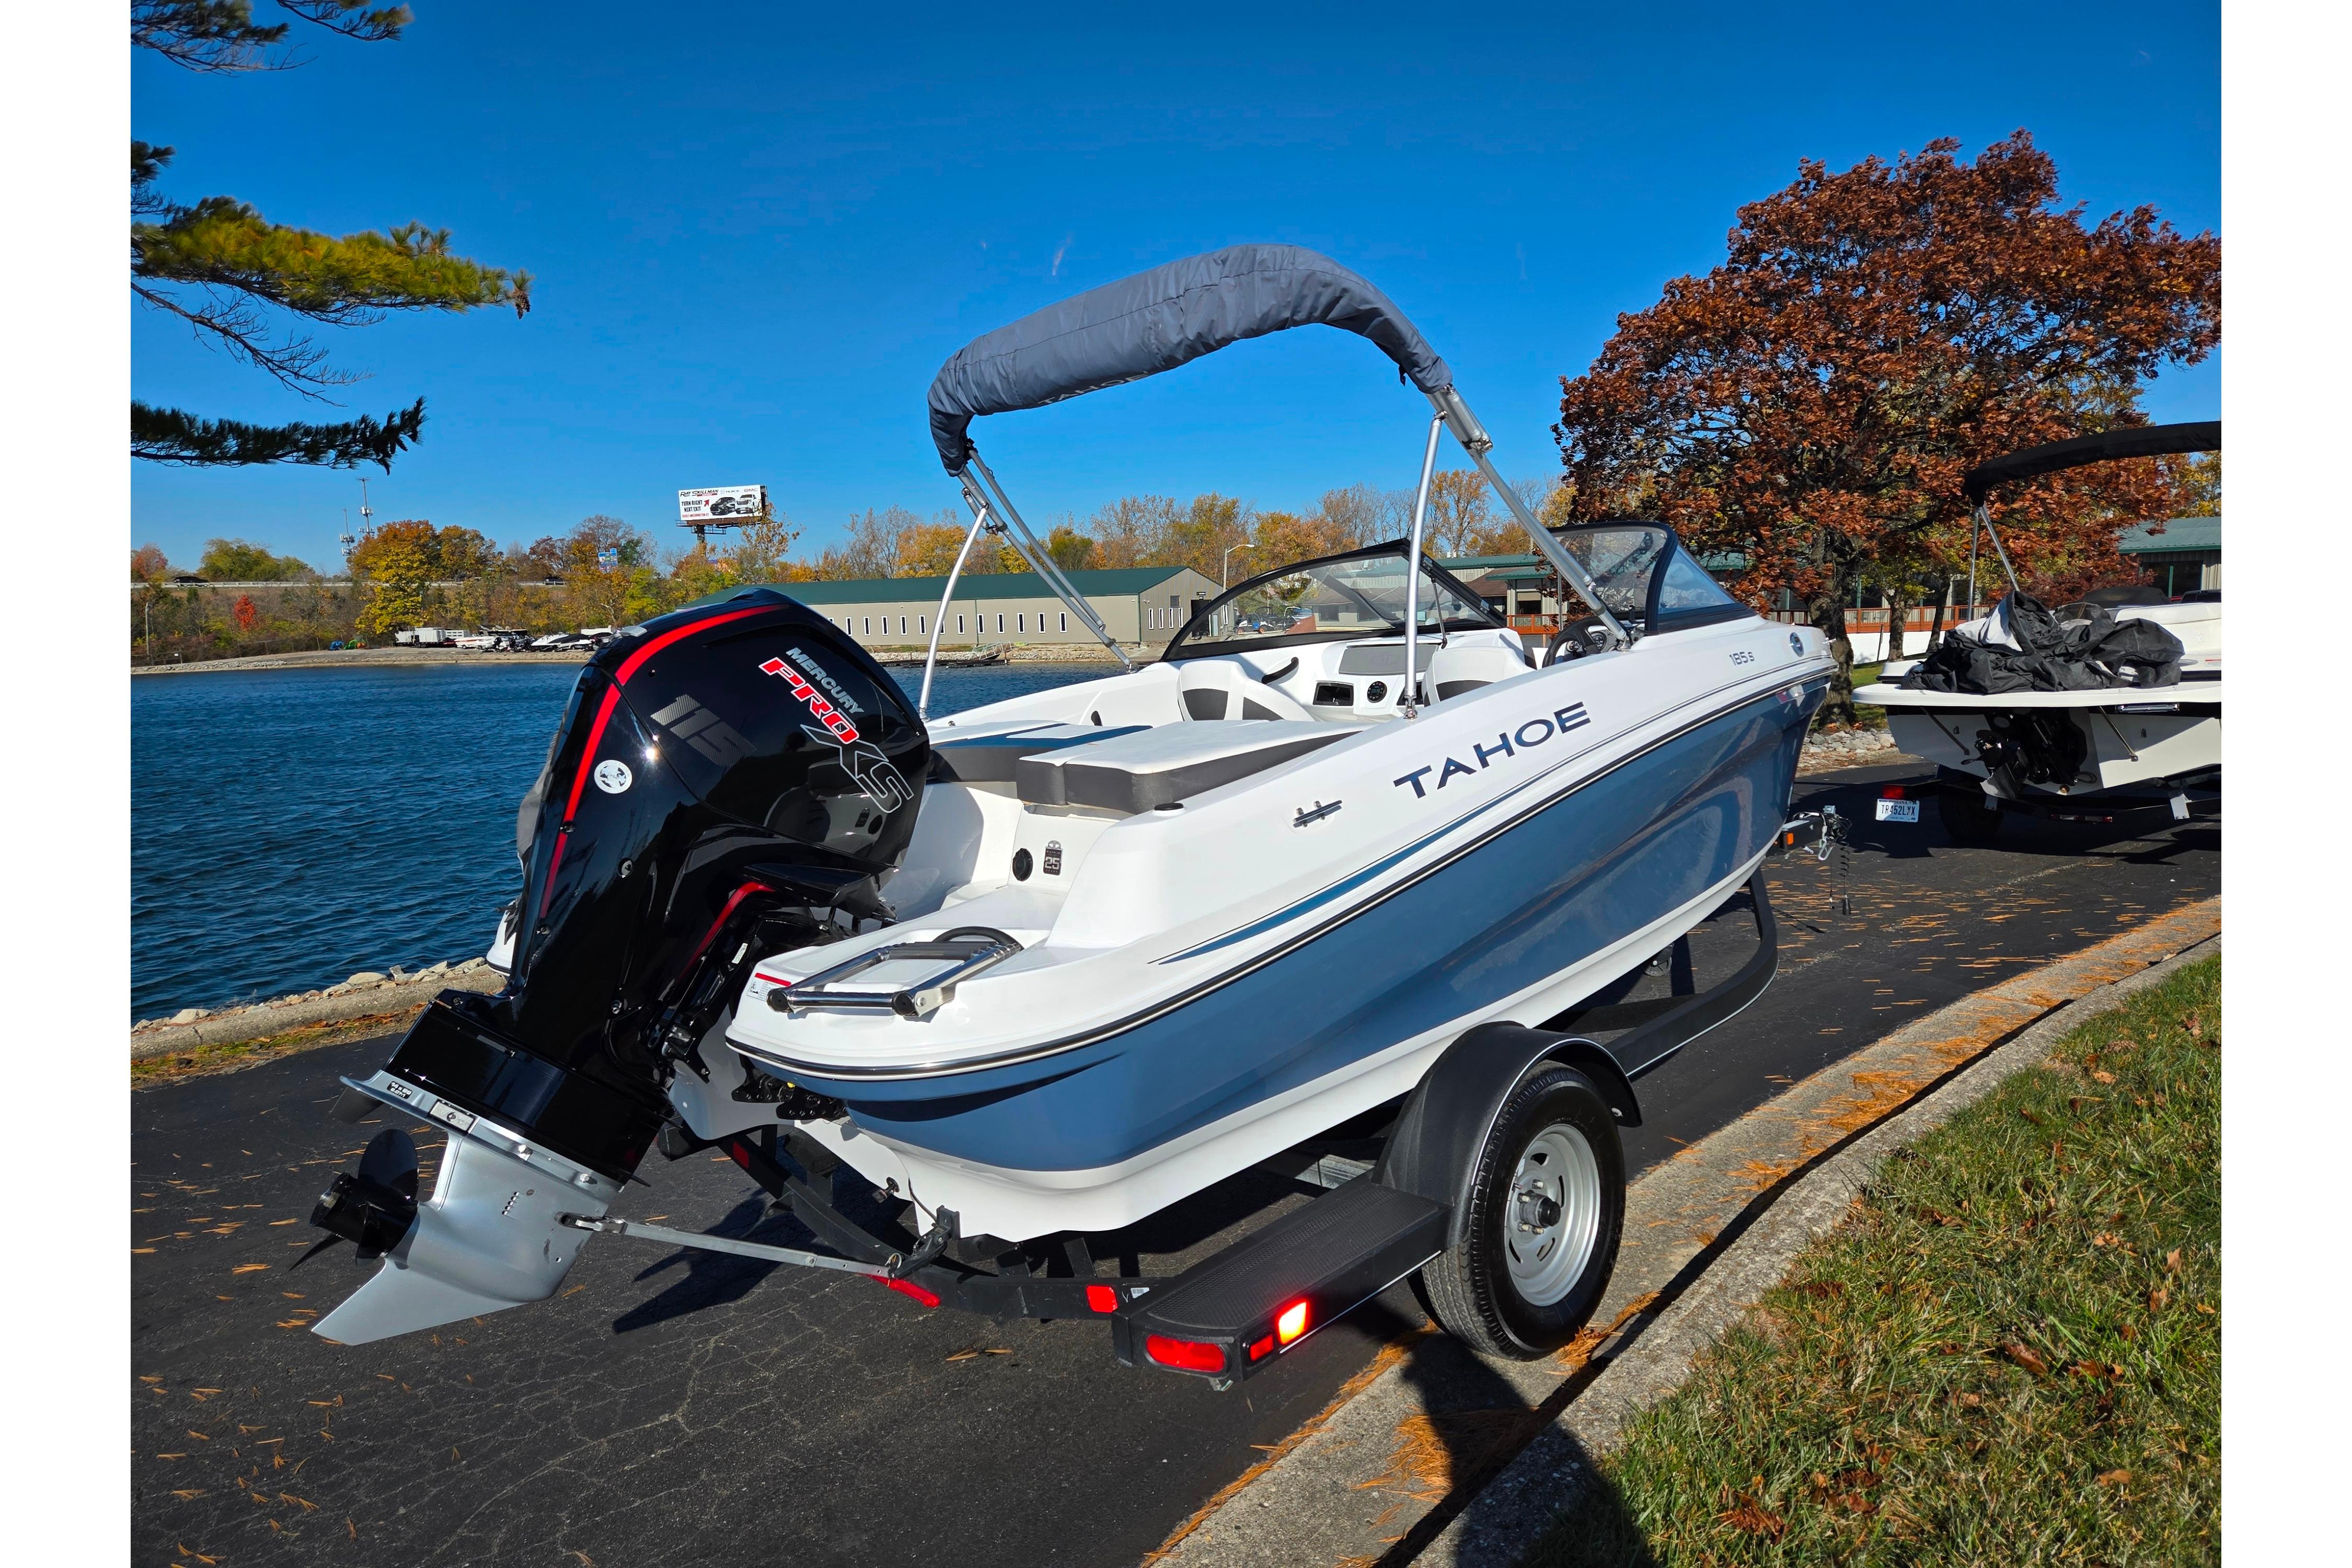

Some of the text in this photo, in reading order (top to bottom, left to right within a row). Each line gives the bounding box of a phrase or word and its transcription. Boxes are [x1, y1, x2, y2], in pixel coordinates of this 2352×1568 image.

[1037, 373, 1148, 405] TAHOE
[786, 647, 864, 713] MERCURY
[650, 694, 757, 766] 115
[758, 656, 914, 813] PRO XS
[1393, 701, 1591, 799] TAHOE
[1881, 804, 1916, 816] TR452LXX
[1045, 856, 1060, 870] 25
